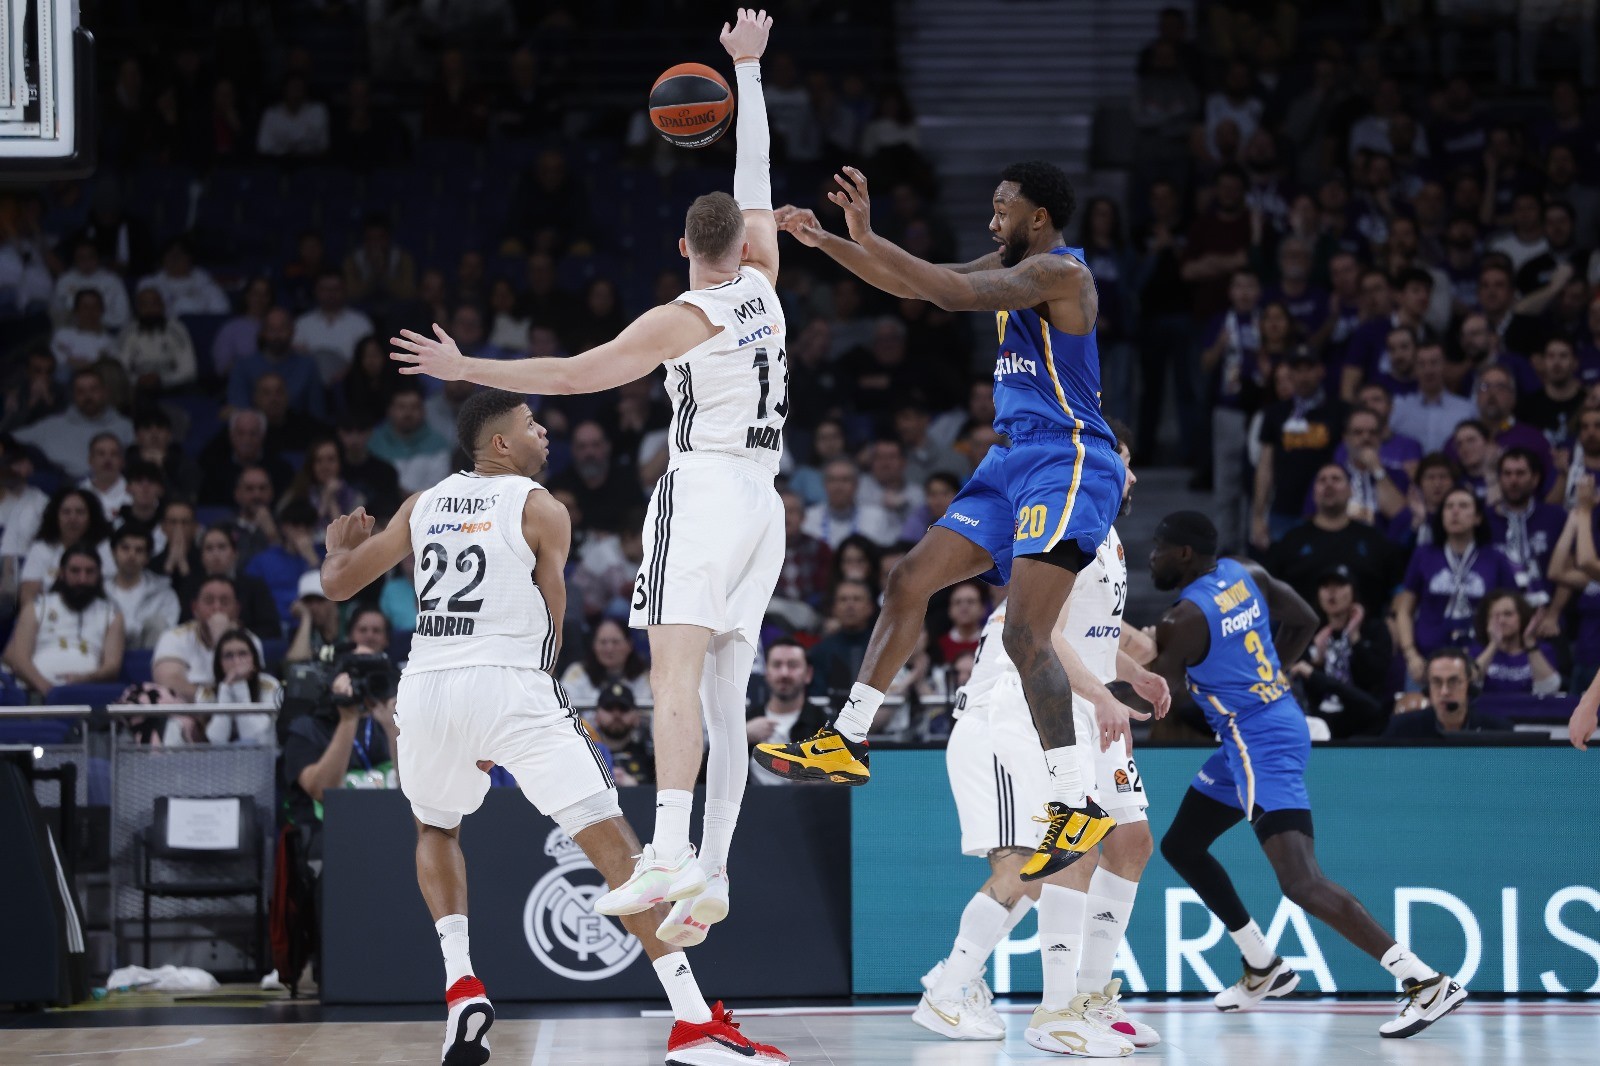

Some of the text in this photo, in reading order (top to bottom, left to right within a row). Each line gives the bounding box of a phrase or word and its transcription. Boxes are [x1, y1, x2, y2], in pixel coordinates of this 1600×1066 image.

[658, 110, 716, 128] SPALDING
[426, 521, 492, 536] AUTOHERO
[950, 512, 981, 527] Rapyd
[1015, 504, 1048, 540] 20
[419, 542, 487, 613] 22
[416, 615, 475, 637] MADRID
[1221, 598, 1261, 637] Rapyd
[1244, 630, 1274, 682] 3
[1394, 885, 1600, 993] DIS
